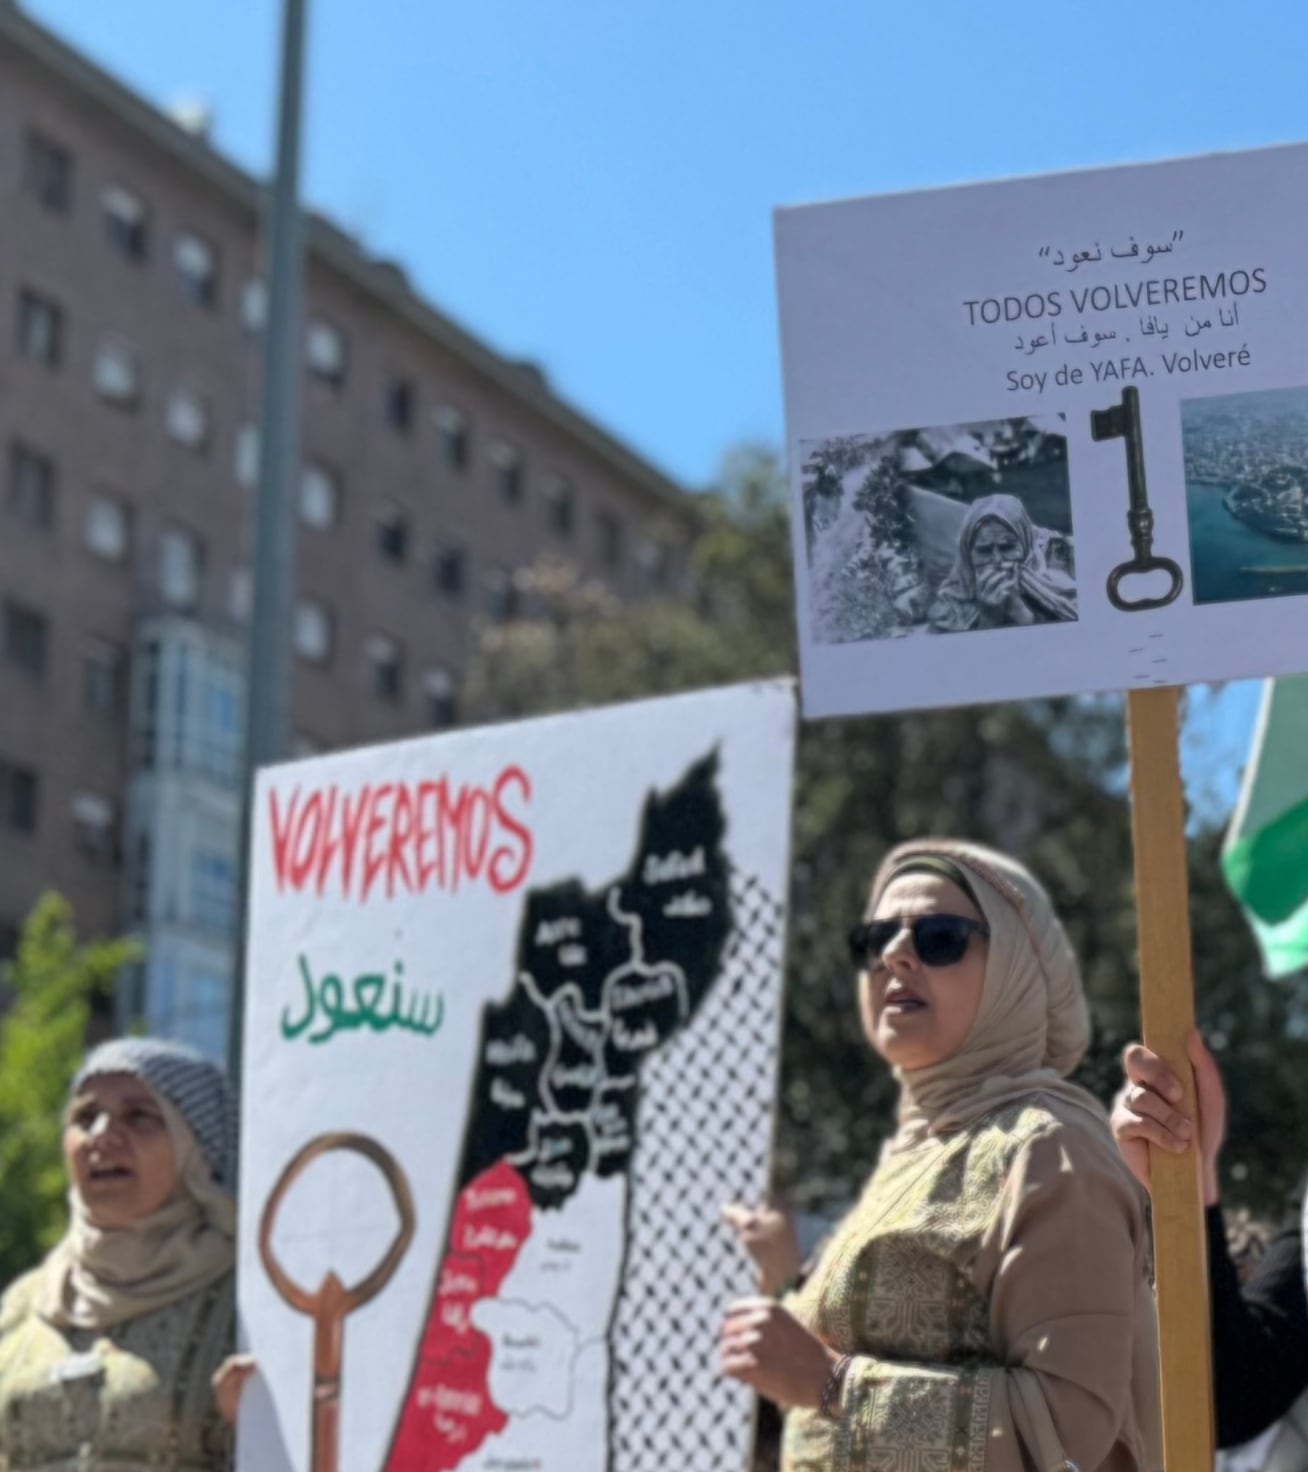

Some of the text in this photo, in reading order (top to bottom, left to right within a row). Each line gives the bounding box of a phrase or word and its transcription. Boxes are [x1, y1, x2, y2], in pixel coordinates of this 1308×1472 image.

[964, 268, 1267, 326] TODOS VOLVEREMOS
[1064, 324, 1117, 349] سوف
[1140, 314, 1169, 340] يافا
[1184, 315, 1212, 338] من
[1006, 343, 1251, 394] Soy de YAFA. Volveré
[268, 763, 533, 906] VOLVEREMOS
